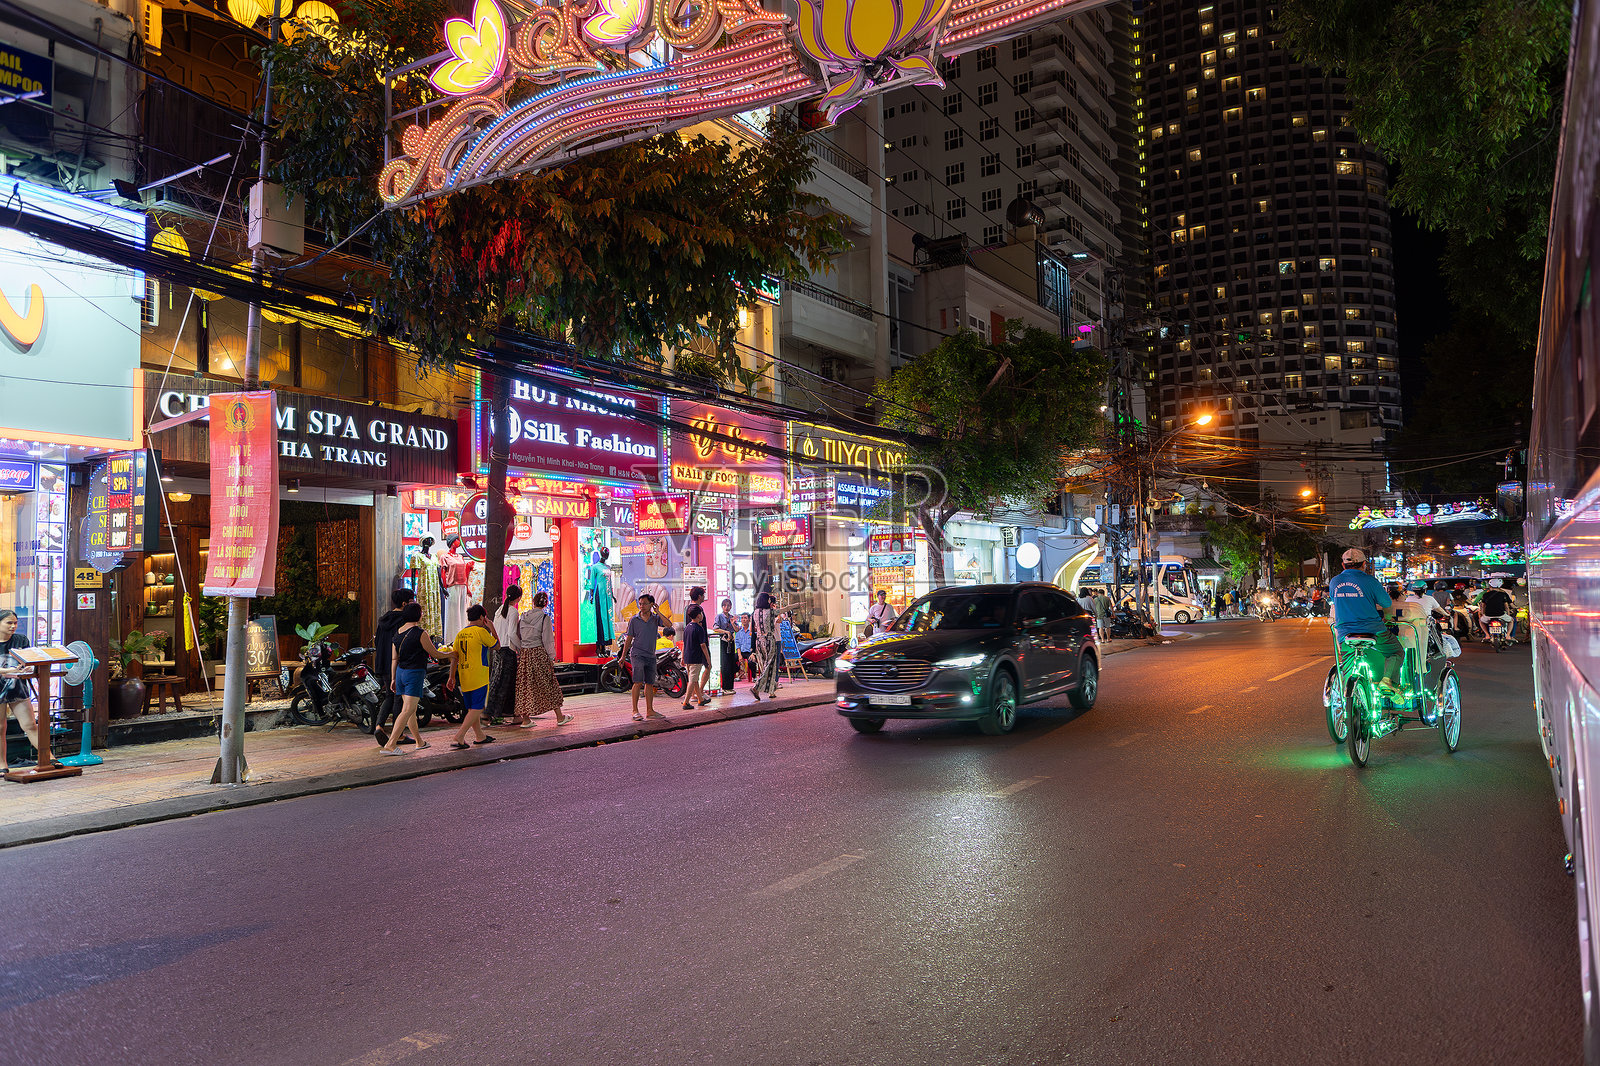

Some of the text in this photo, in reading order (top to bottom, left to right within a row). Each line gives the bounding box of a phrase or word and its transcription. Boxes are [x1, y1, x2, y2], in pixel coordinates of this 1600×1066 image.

[160, 391, 448, 450] CHM SPA GRAND
[524, 419, 657, 458] Silk Fashion
[278, 440, 387, 467] HA TRANG
[111, 458, 131, 474] WOW
[676, 466, 702, 480] NAIL
[704, 470, 713, 480] &
[715, 472, 738, 484] FOOT
[113, 476, 128, 491] SPA
[460, 524, 477, 538] HUY
